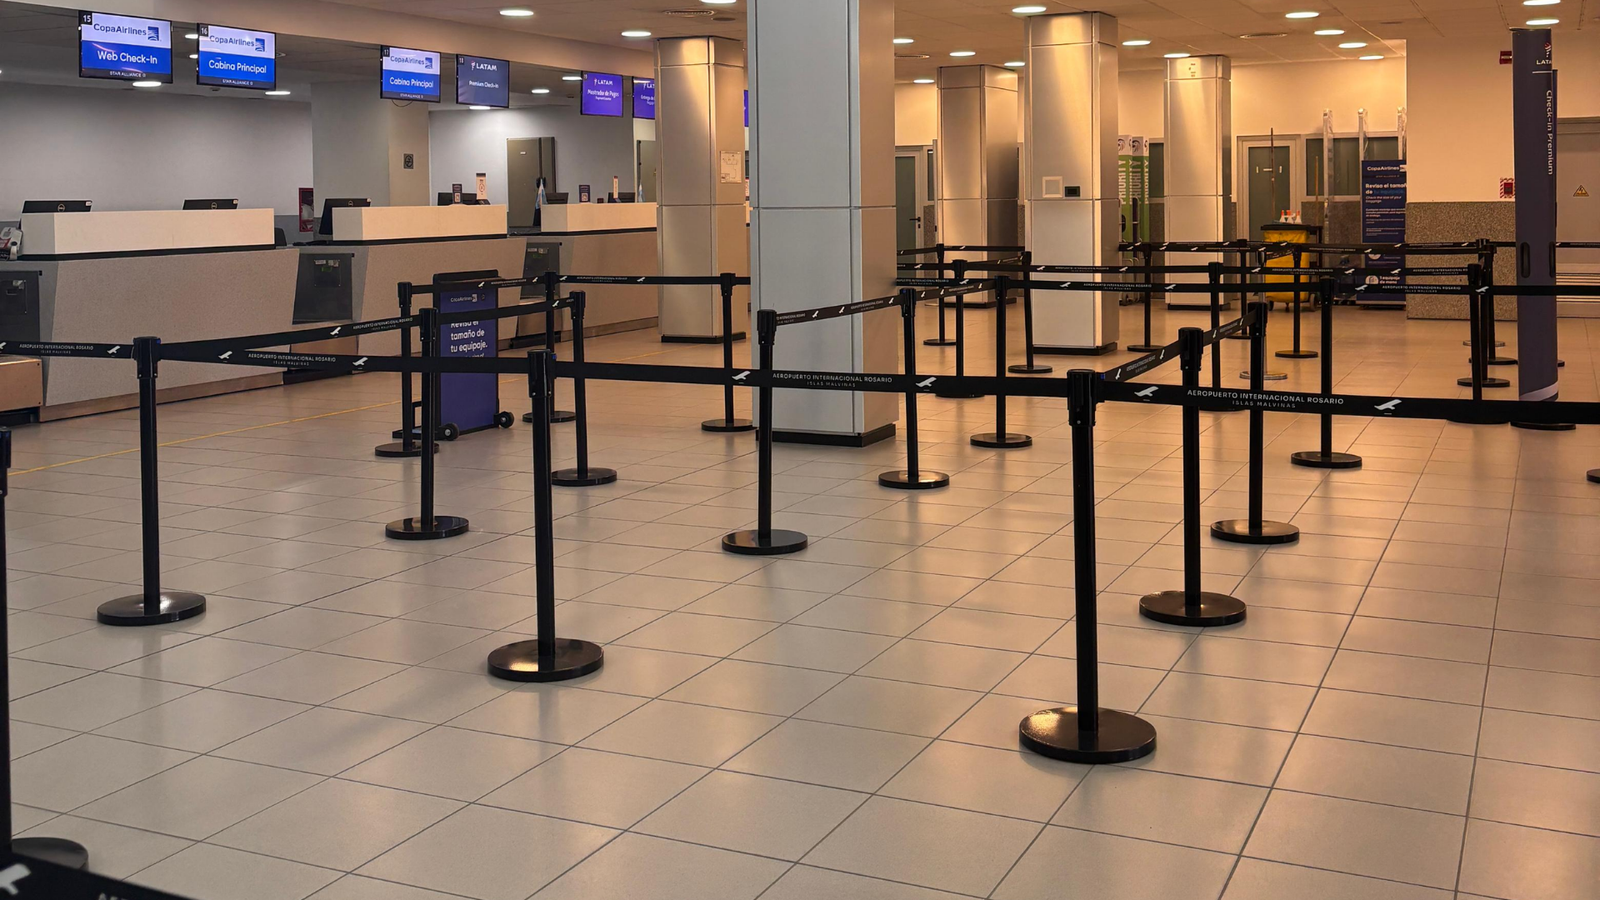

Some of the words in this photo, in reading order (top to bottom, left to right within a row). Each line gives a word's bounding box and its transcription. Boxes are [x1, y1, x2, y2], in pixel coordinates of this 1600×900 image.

[93, 24, 146, 36] CopaAirlines
[210, 35, 255, 46] CopaAirlines
[97, 50, 118, 61] Web
[120, 52, 158, 64] Check-In
[390, 56, 424, 65] CopaAirlines
[208, 59, 235, 70] Cabina
[237, 63, 266, 74] Principal
[476, 63, 497, 71] LATAM
[390, 77, 410, 86] Cabina
[411, 79, 434, 88] Principal
[451, 330, 475, 340] tamaño
[477, 328, 485, 336] de
[459, 340, 488, 352] equipaje.
[1187, 389, 1238, 399] AEROPUERTO
[1240, 393, 1305, 403] INTERNACIONAL
[1307, 397, 1344, 405] ROSARIO
